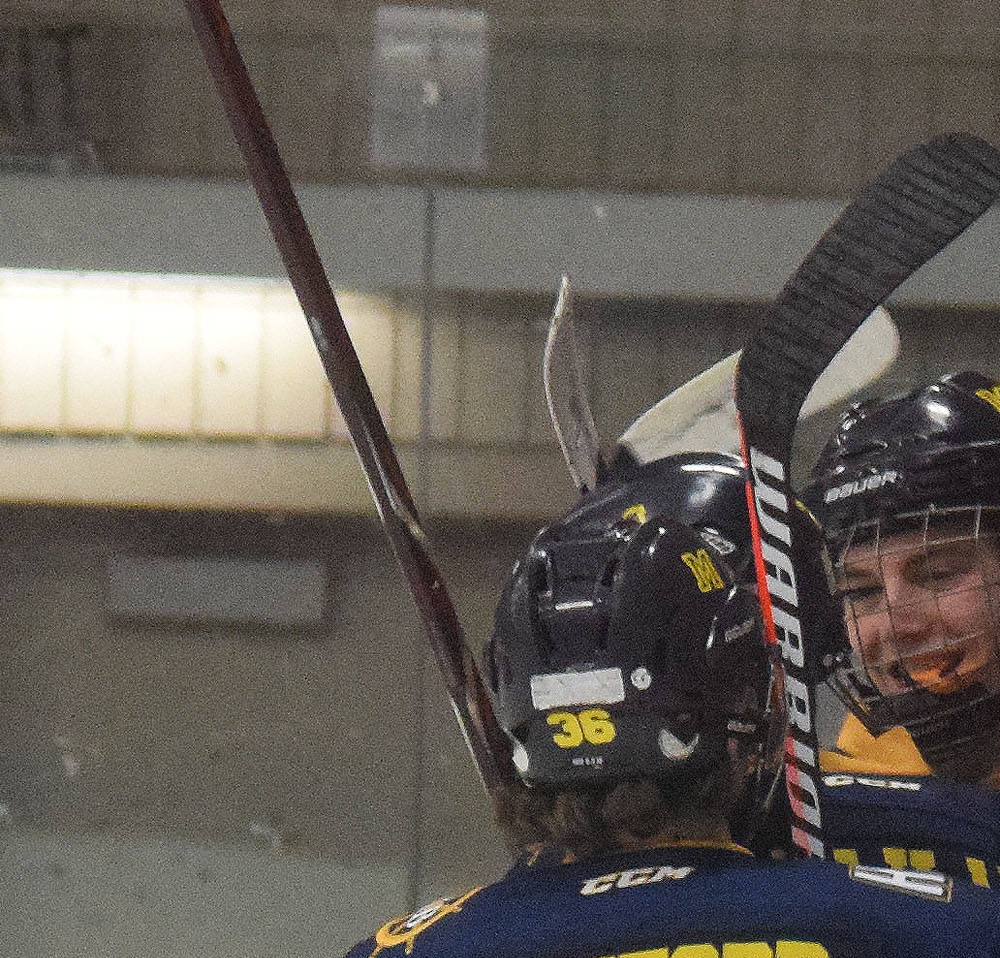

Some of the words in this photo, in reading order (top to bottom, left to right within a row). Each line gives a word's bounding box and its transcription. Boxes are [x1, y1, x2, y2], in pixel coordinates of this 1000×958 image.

[823, 468, 900, 505] BAUER
[680, 548, 725, 593] M
[546, 708, 618, 749] 36
[579, 863, 697, 897] CCM
